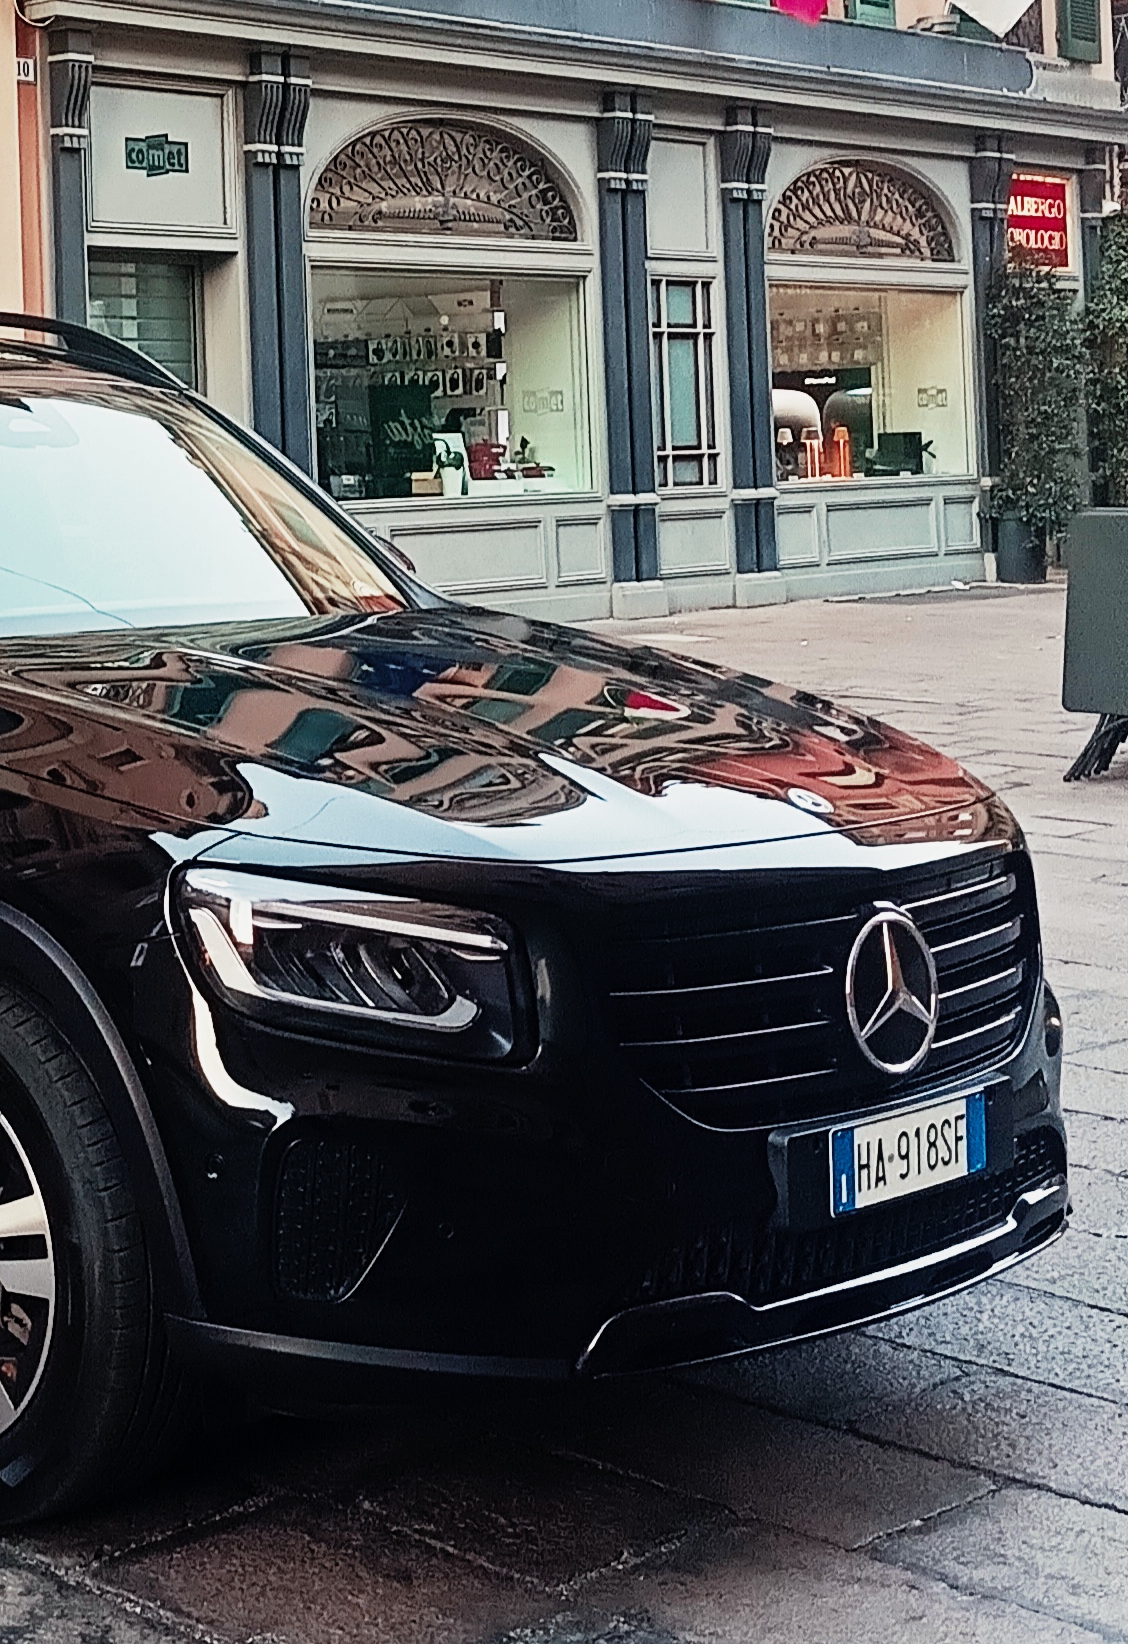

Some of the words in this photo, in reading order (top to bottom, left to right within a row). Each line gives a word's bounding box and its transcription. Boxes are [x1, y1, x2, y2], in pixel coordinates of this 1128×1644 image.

[17, 61, 30, 77] 10
[127, 147, 184, 168] comet
[1007, 196, 1064, 218] ALBERGO
[1007, 228, 1067, 249] OROLOGIO
